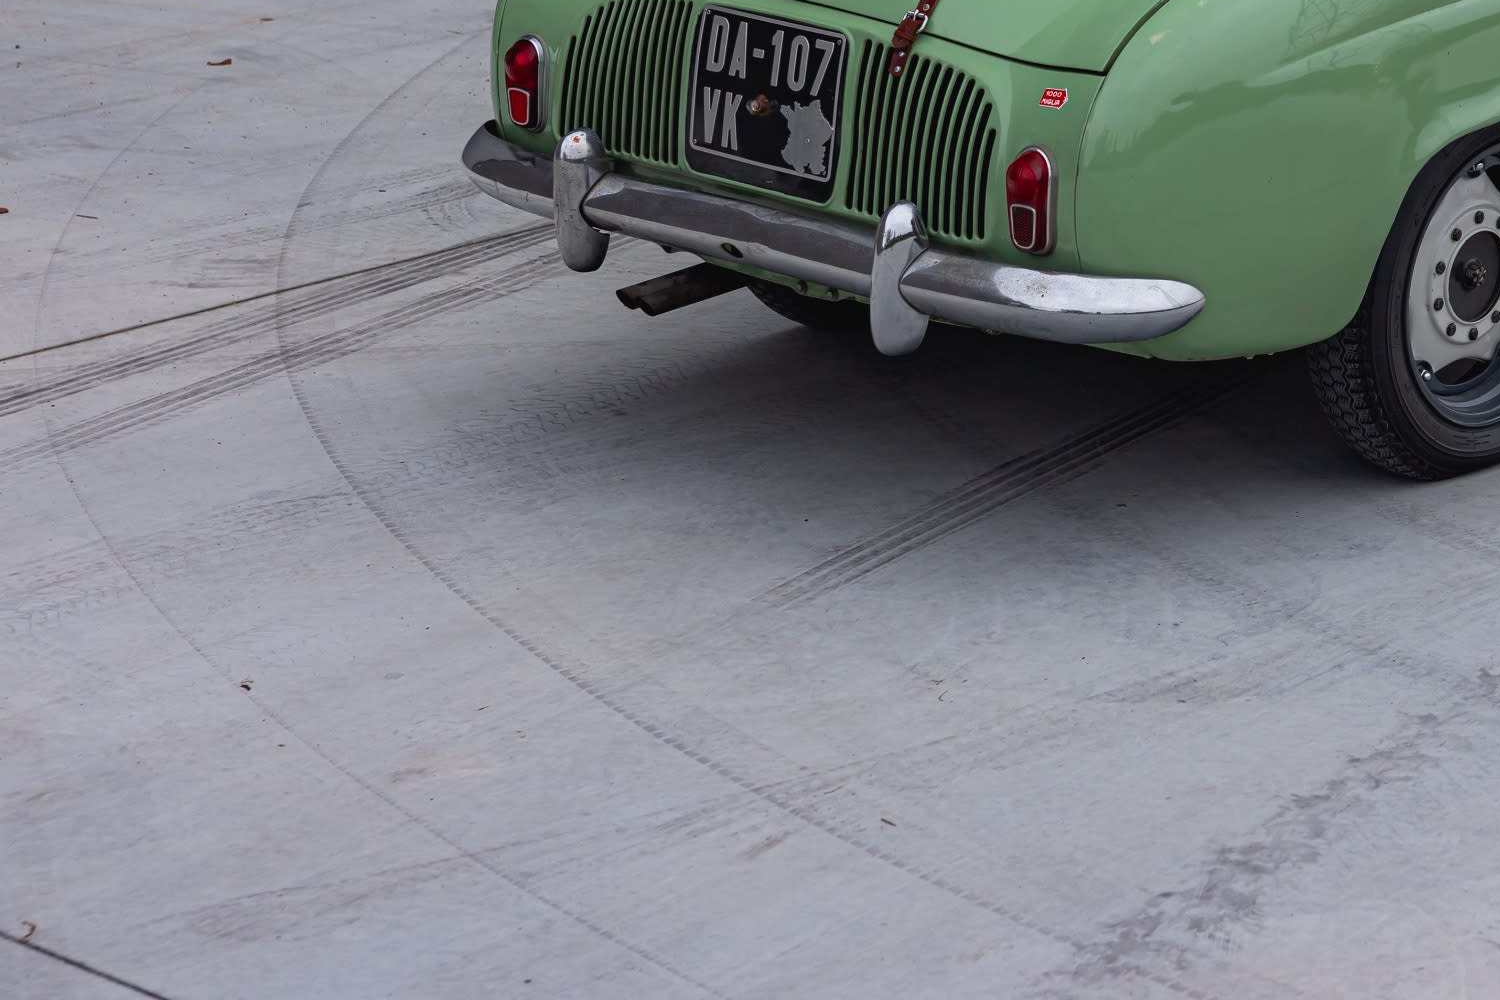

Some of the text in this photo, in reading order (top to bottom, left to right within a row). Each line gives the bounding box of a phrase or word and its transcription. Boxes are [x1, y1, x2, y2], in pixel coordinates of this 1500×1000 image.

[706, 15, 835, 96] DA-107
[703, 86, 743, 151] VK
[1046, 90, 1062, 98] 1000
